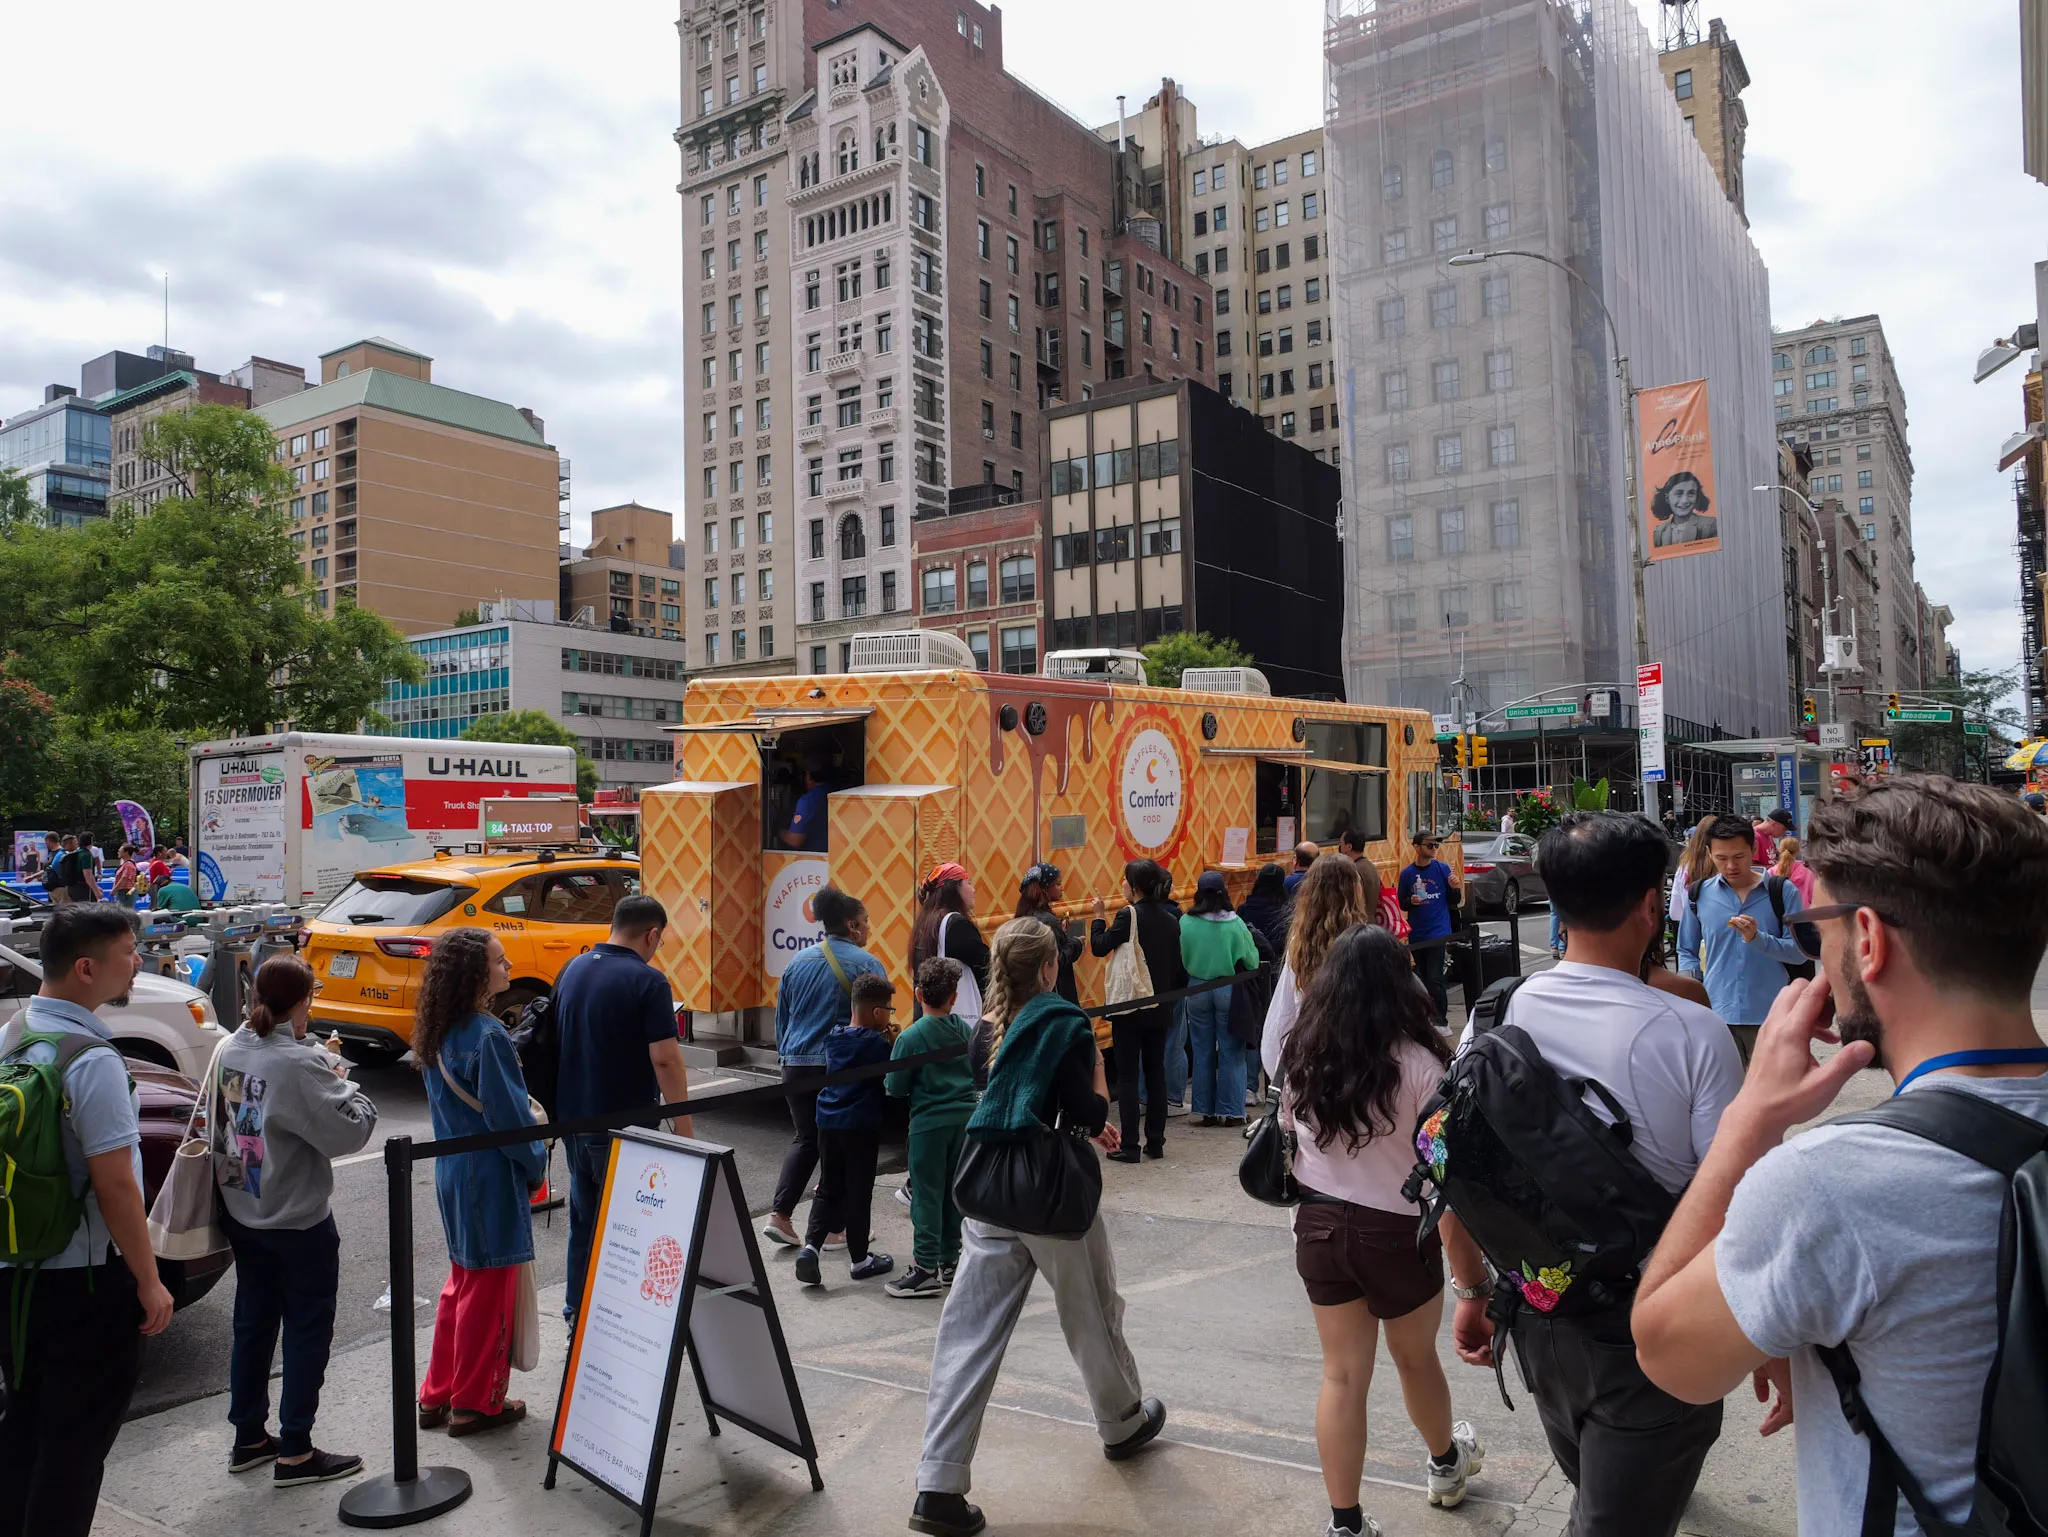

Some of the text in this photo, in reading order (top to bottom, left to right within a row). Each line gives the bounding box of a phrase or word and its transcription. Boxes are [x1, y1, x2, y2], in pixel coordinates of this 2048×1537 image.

[1644, 431, 1706, 451] Anne Frank
[1508, 706, 1575, 716] Union Square West
[1642, 729, 1647, 738] 2
[1128, 744, 1157, 775] WAFFLES
[1159, 749, 1170, 768] ARE
[1860, 747, 1874, 761] $1
[222, 760, 259, 774] U-HAUL
[428, 757, 528, 778] U-HAUL
[1860, 761, 1876, 775] $2
[217, 785, 282, 804] SUPERMOVER
[1129, 789, 1174, 808] Comfort
[1783, 780, 1792, 809] Bicycle
[467, 802, 480, 810] Sha
[1142, 815, 1161, 823] FOOD
[492, 823, 553, 833] 844-TAXI-TOP
[773, 875, 821, 909] WAFFLES
[772, 928, 825, 951] Comf
[360, 986, 389, 1000] A1166
[635, 1190, 664, 1209] Comfort
[641, 1208, 653, 1217] FOOD
[612, 1222, 637, 1237] WAFFLES
[597, 1303, 622, 1319] Chocolate Lover
[585, 1361, 612, 1381] Comfort Cravings
[572, 1432, 644, 1481] VISIT OUR LATTE BAR INSIDE!
